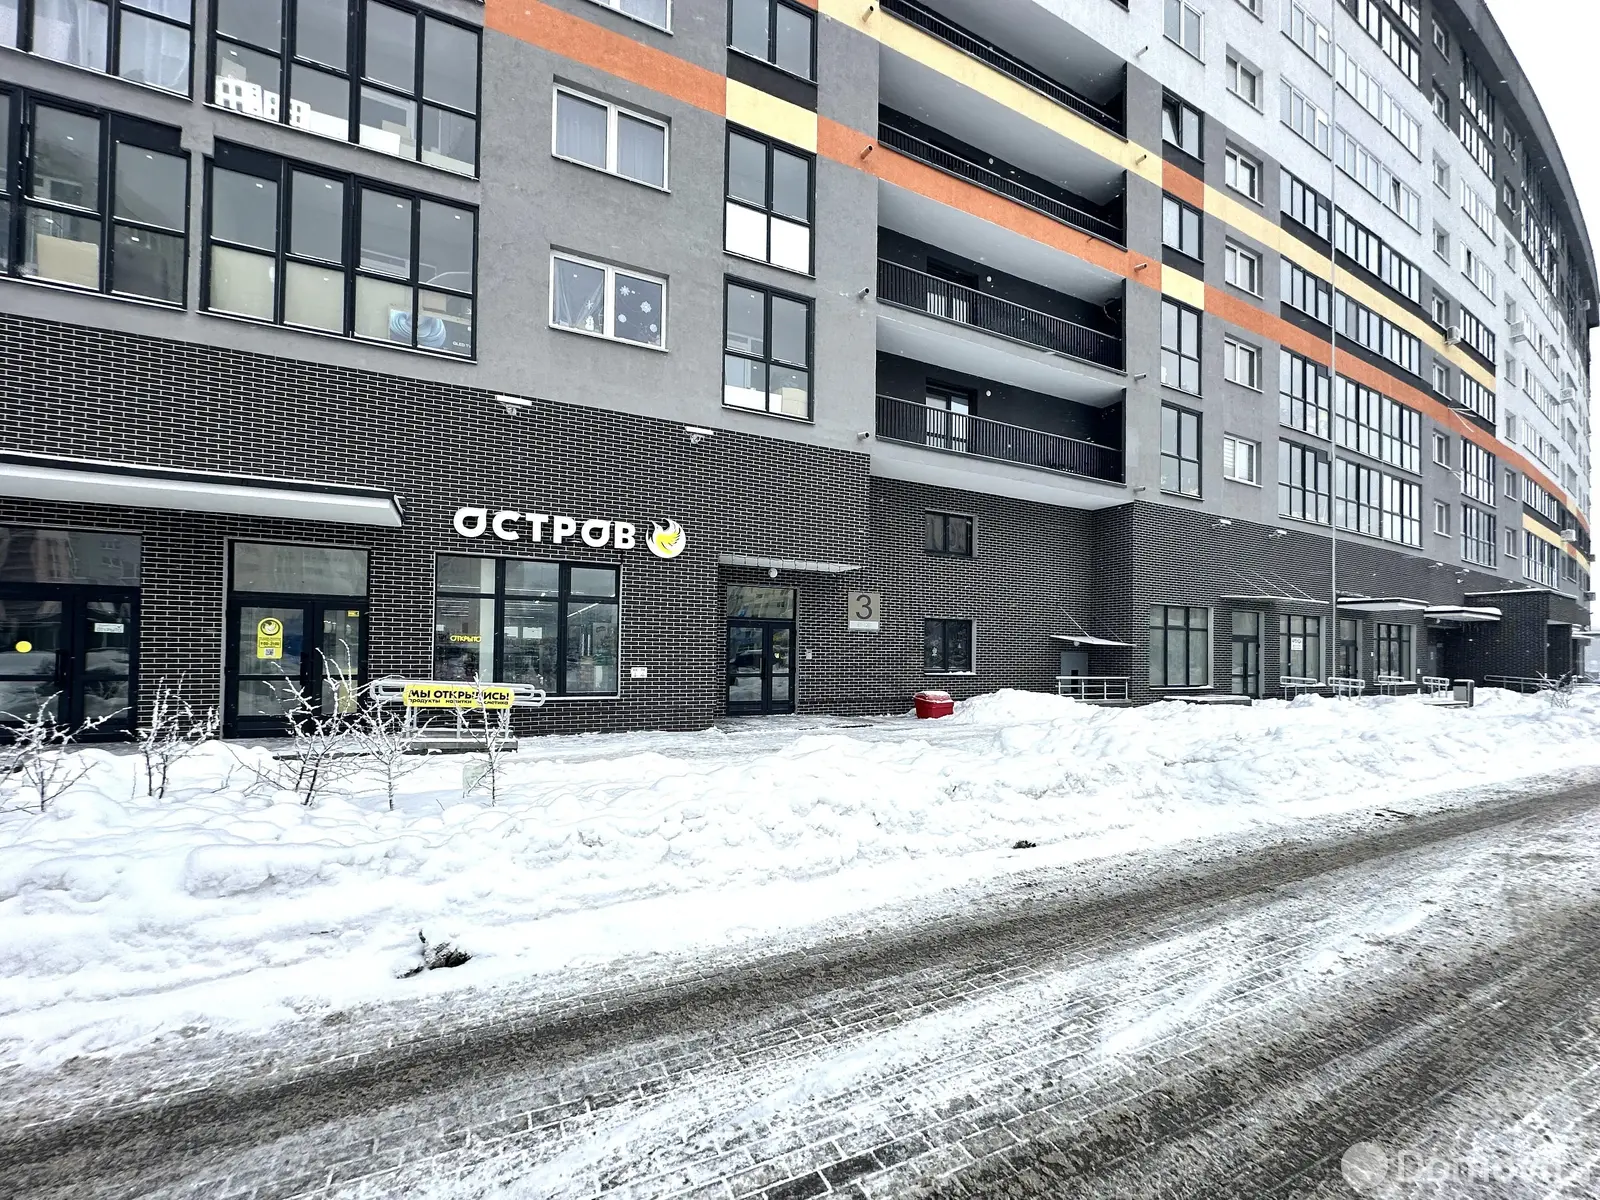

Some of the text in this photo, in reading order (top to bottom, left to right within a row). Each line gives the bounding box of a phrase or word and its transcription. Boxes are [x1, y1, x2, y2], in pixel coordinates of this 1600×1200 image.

[453, 506, 636, 550] ОСТРОВ
[856, 594, 873, 620] 3
[450, 635, 482, 643] ОТКРЫТО
[408, 690, 430, 698] МЫ
